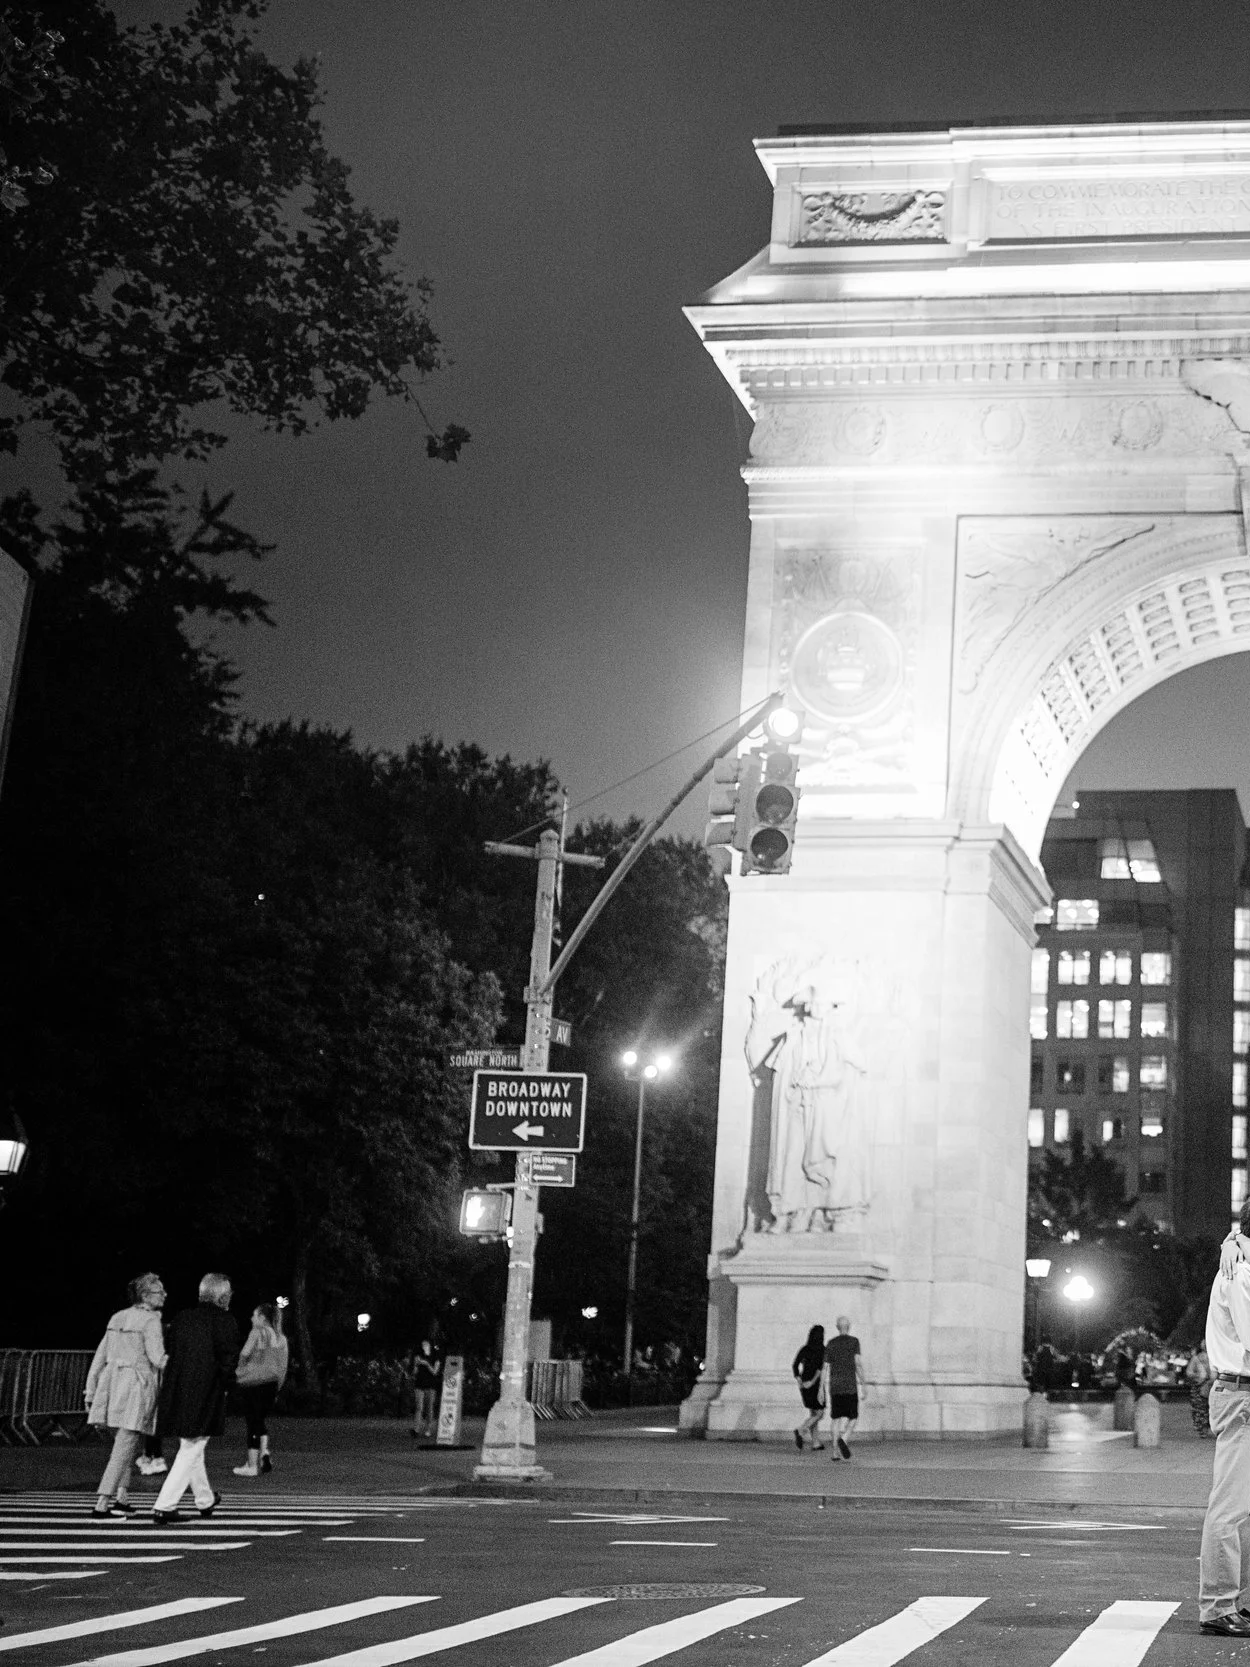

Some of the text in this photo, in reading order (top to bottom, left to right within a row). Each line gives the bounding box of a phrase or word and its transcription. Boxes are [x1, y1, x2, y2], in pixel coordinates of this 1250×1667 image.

[998, 183, 1024, 201] TO
[1027, 180, 1190, 201] COMMEMORATE
[1192, 177, 1237, 196] THE
[996, 202, 1024, 219] OF
[1033, 200, 1077, 218] THE
[556, 1025, 569, 1043] AV
[449, 1055, 518, 1067] SQUARE NORTH
[488, 1081, 571, 1098] BROADWAY
[485, 1100, 572, 1117] DOWNTOWN
